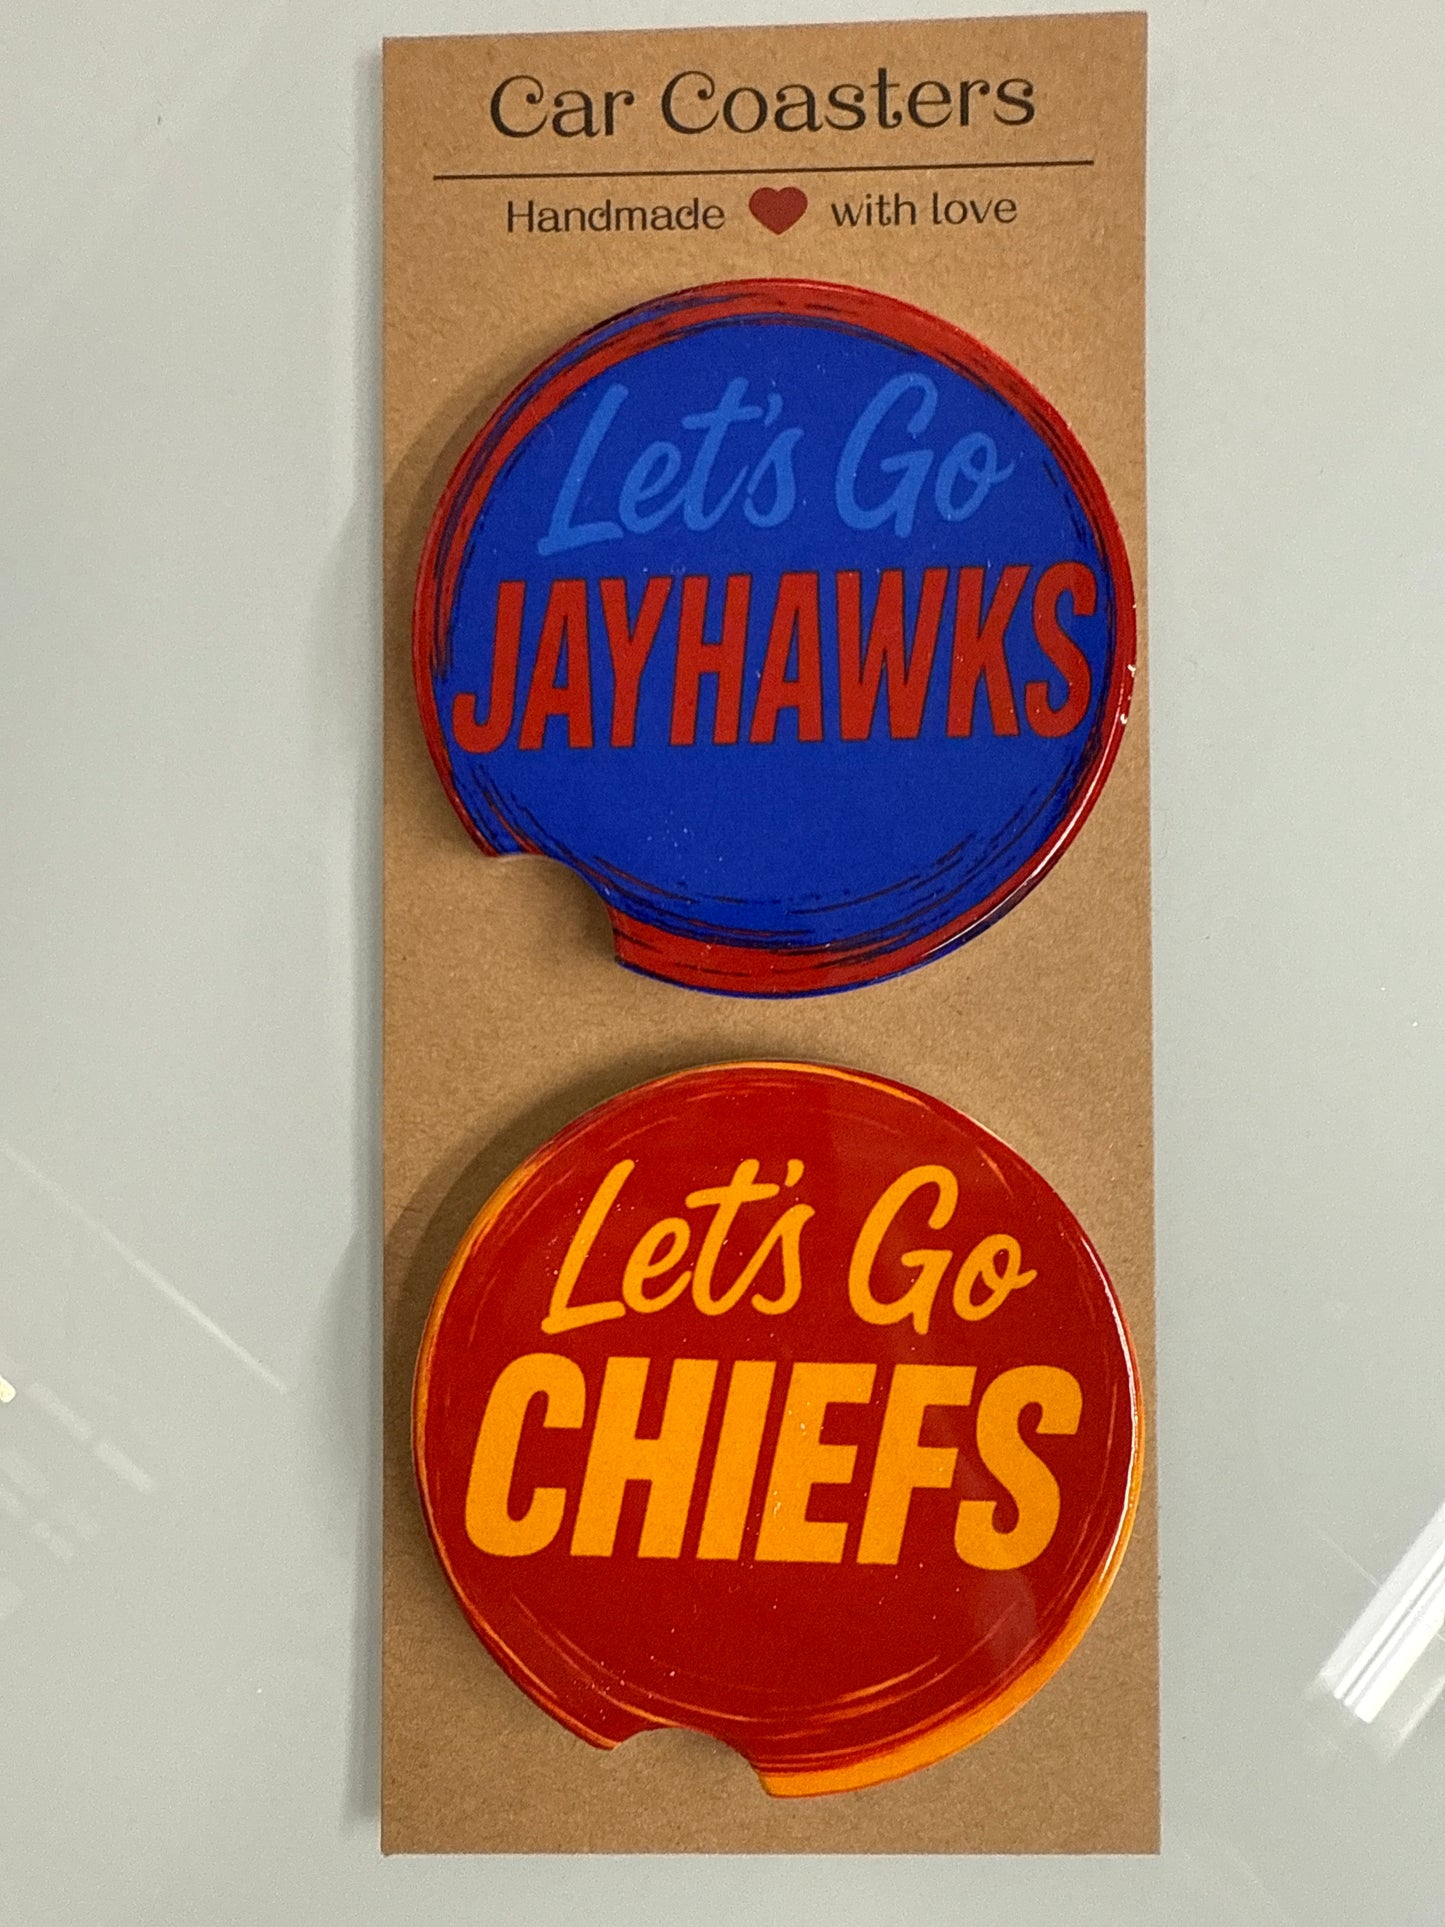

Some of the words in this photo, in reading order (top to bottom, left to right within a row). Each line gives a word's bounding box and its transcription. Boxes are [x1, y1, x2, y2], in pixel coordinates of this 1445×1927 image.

[490, 74, 635, 139] Car
[661, 67, 1036, 135] Coasters
[507, 198, 726, 233] Handmade
[830, 193, 917, 227] with
[932, 191, 1018, 225] love
[537, 377, 805, 556] Let's
[834, 373, 1015, 539] Go
[452, 562, 1097, 753] JAYHAWKS
[541, 1159, 815, 1335] Let's
[848, 1164, 1037, 1334] Go
[465, 1353, 1083, 1571] CHIEFS
